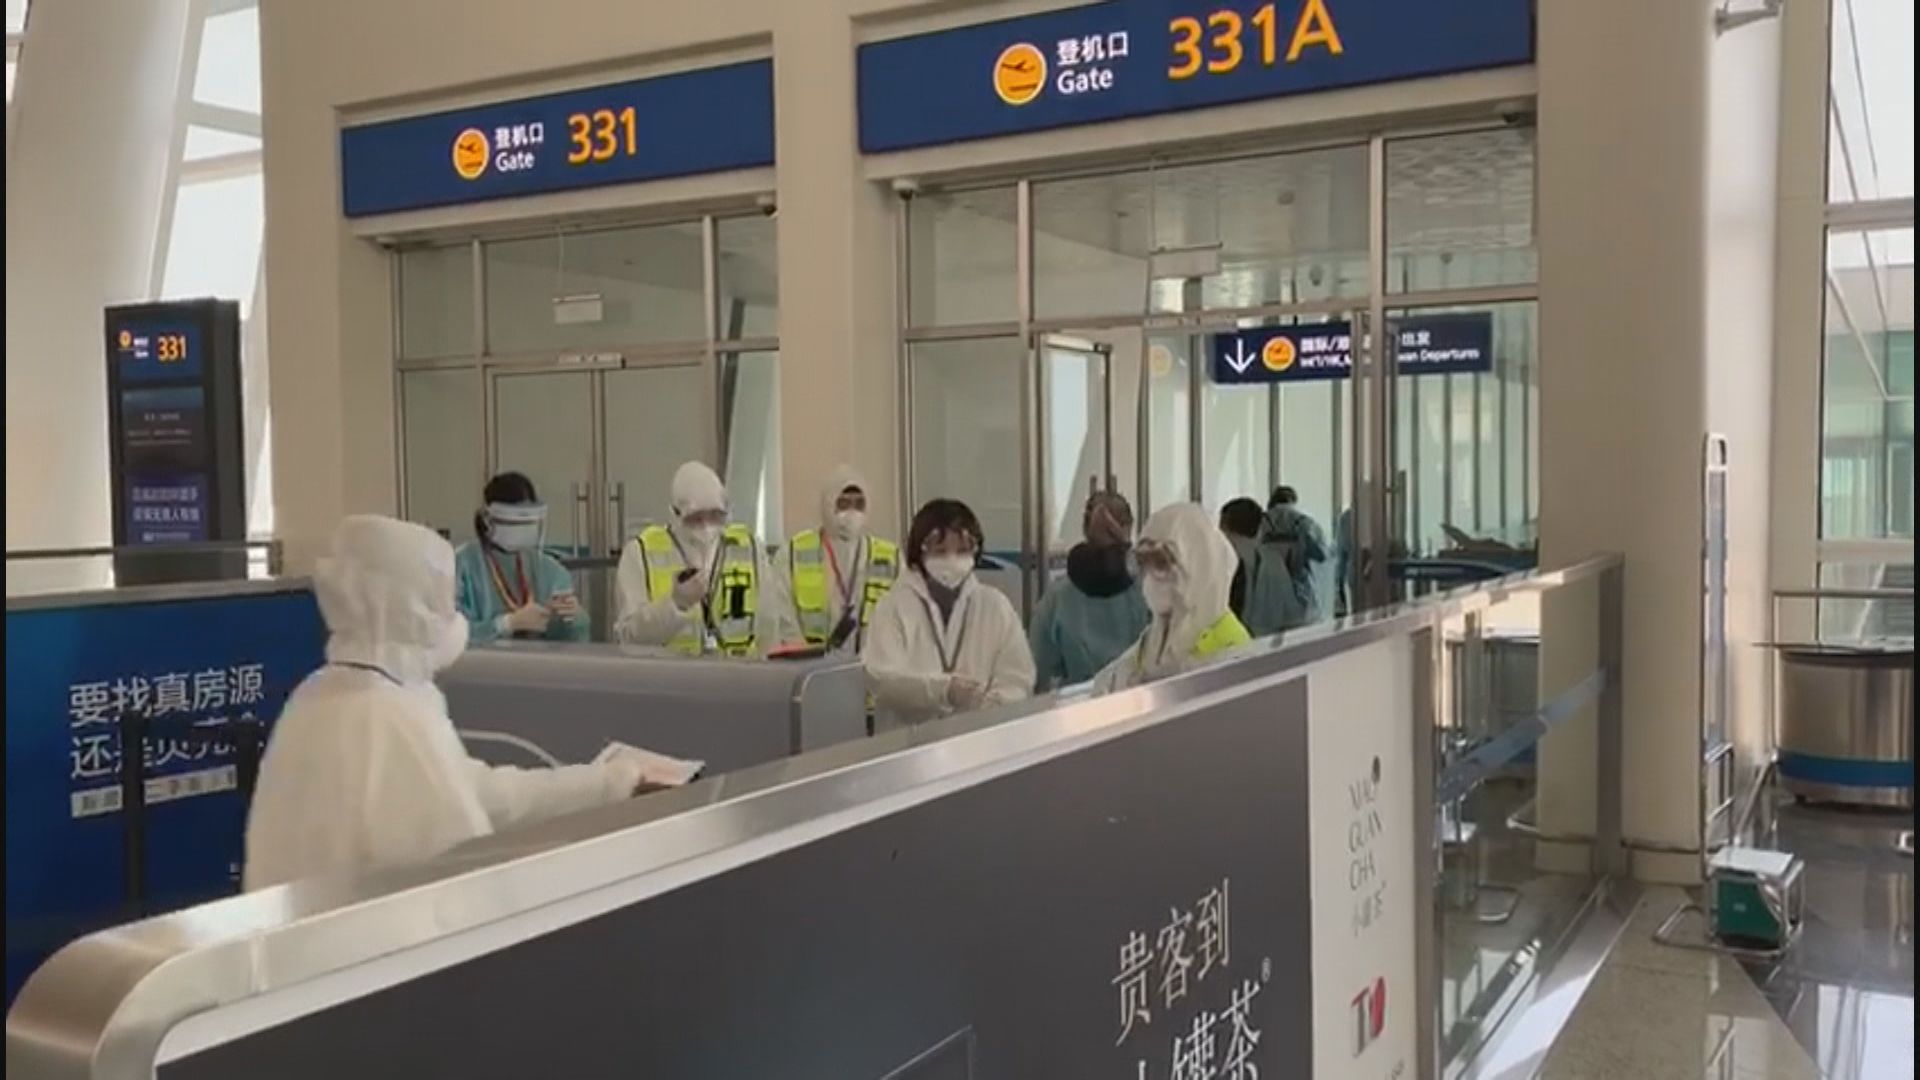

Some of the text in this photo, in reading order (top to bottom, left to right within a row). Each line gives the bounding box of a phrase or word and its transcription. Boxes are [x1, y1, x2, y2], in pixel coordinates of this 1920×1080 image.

[1056, 31, 1129, 66] 登机口
[1167, 0, 1344, 80] 331A
[1056, 66, 1114, 95] Gate
[495, 121, 544, 149] 登机口
[567, 106, 638, 164] 331
[495, 148, 534, 172] Gate
[157, 335, 187, 362] 331
[69, 664, 265, 728] 要找真房源
[1111, 877, 1230, 1047] 贵客到
[1137, 977, 1263, 1080] 罐茶
